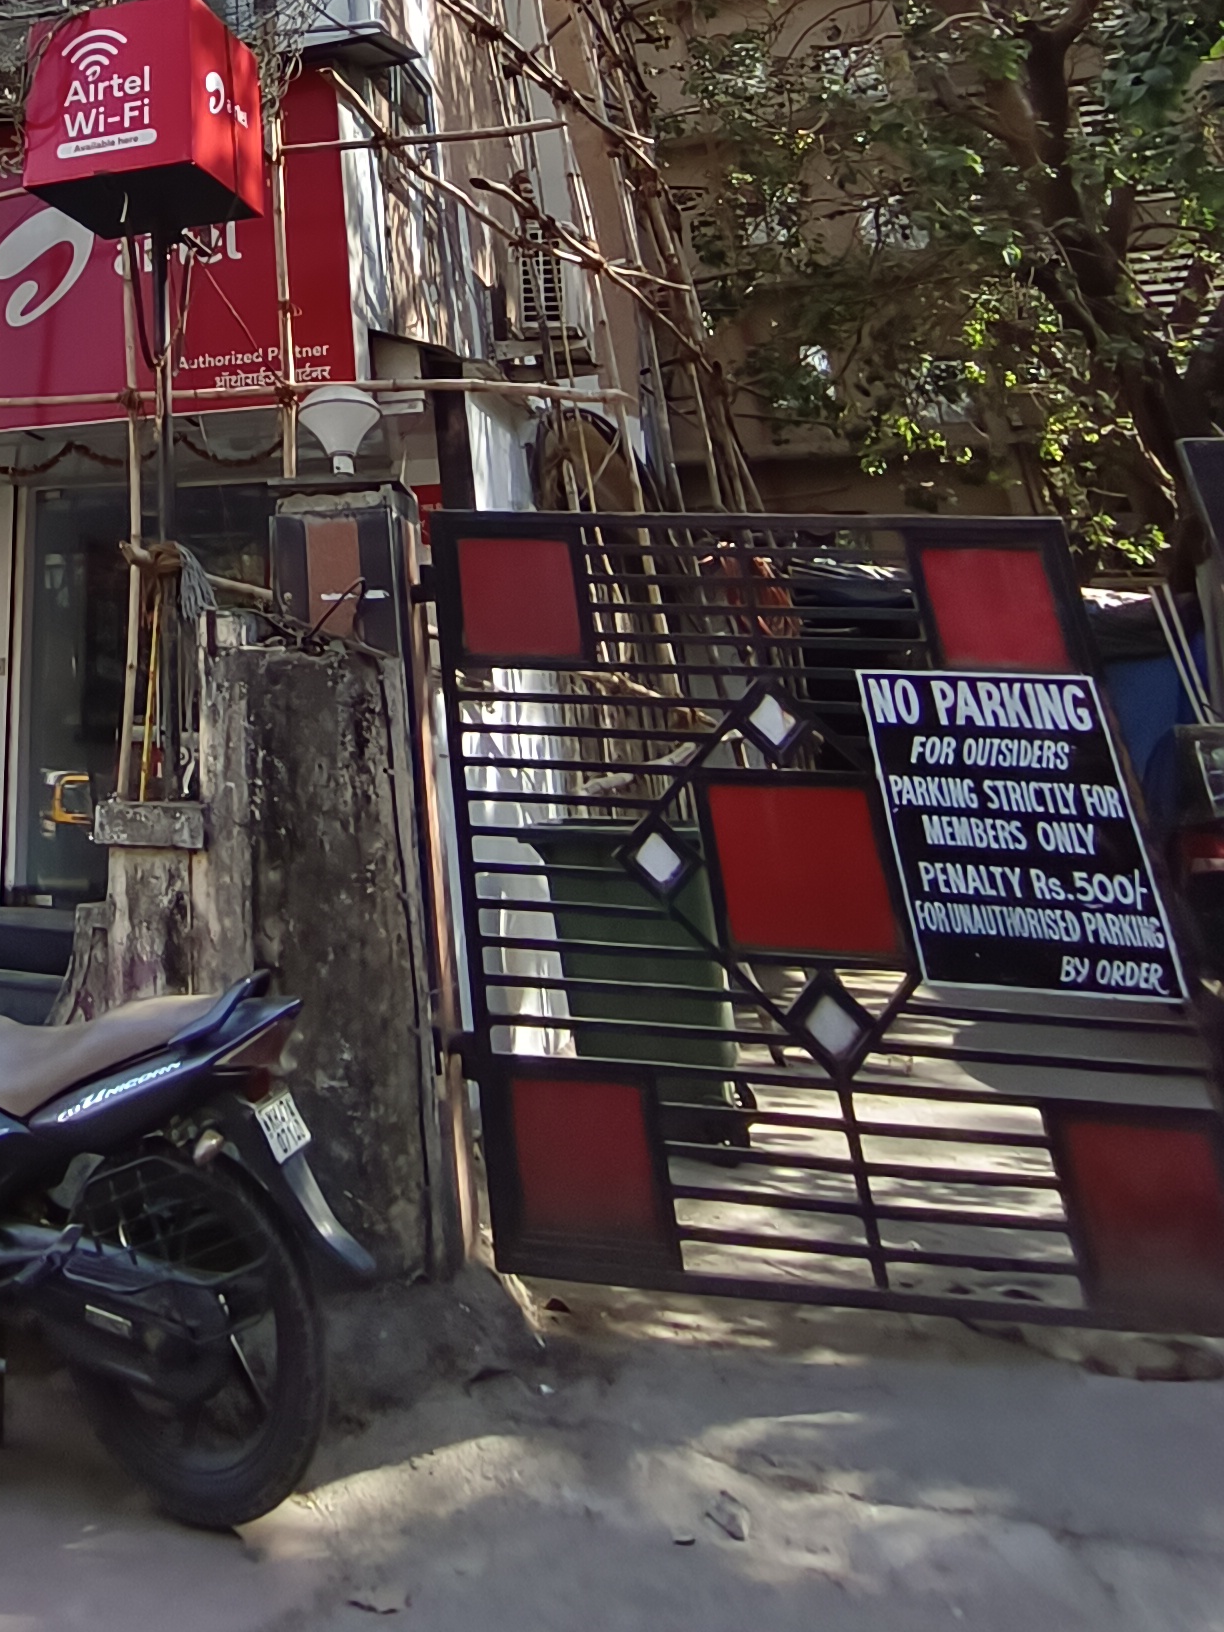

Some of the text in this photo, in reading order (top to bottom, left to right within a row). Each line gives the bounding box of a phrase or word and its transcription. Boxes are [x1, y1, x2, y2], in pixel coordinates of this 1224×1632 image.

[64, 66, 150, 107] Airtel
[64, 98, 150, 137] Wi-Fi
[179, 344, 329, 369] Authorized Ptner
[868, 678, 1093, 731] NO PARKING
[911, 736, 1069, 770] FOR OUTSIDERS
[889, 775, 1125, 818] PARKING STRICTLY FOR
[922, 815, 1096, 855] MEMBERS ONLY
[918, 861, 1022, 898] PENALTY
[915, 901, 1166, 949] FOR UNAUTHORISED PARKING
[1060, 956, 1169, 995] BY ORDER
